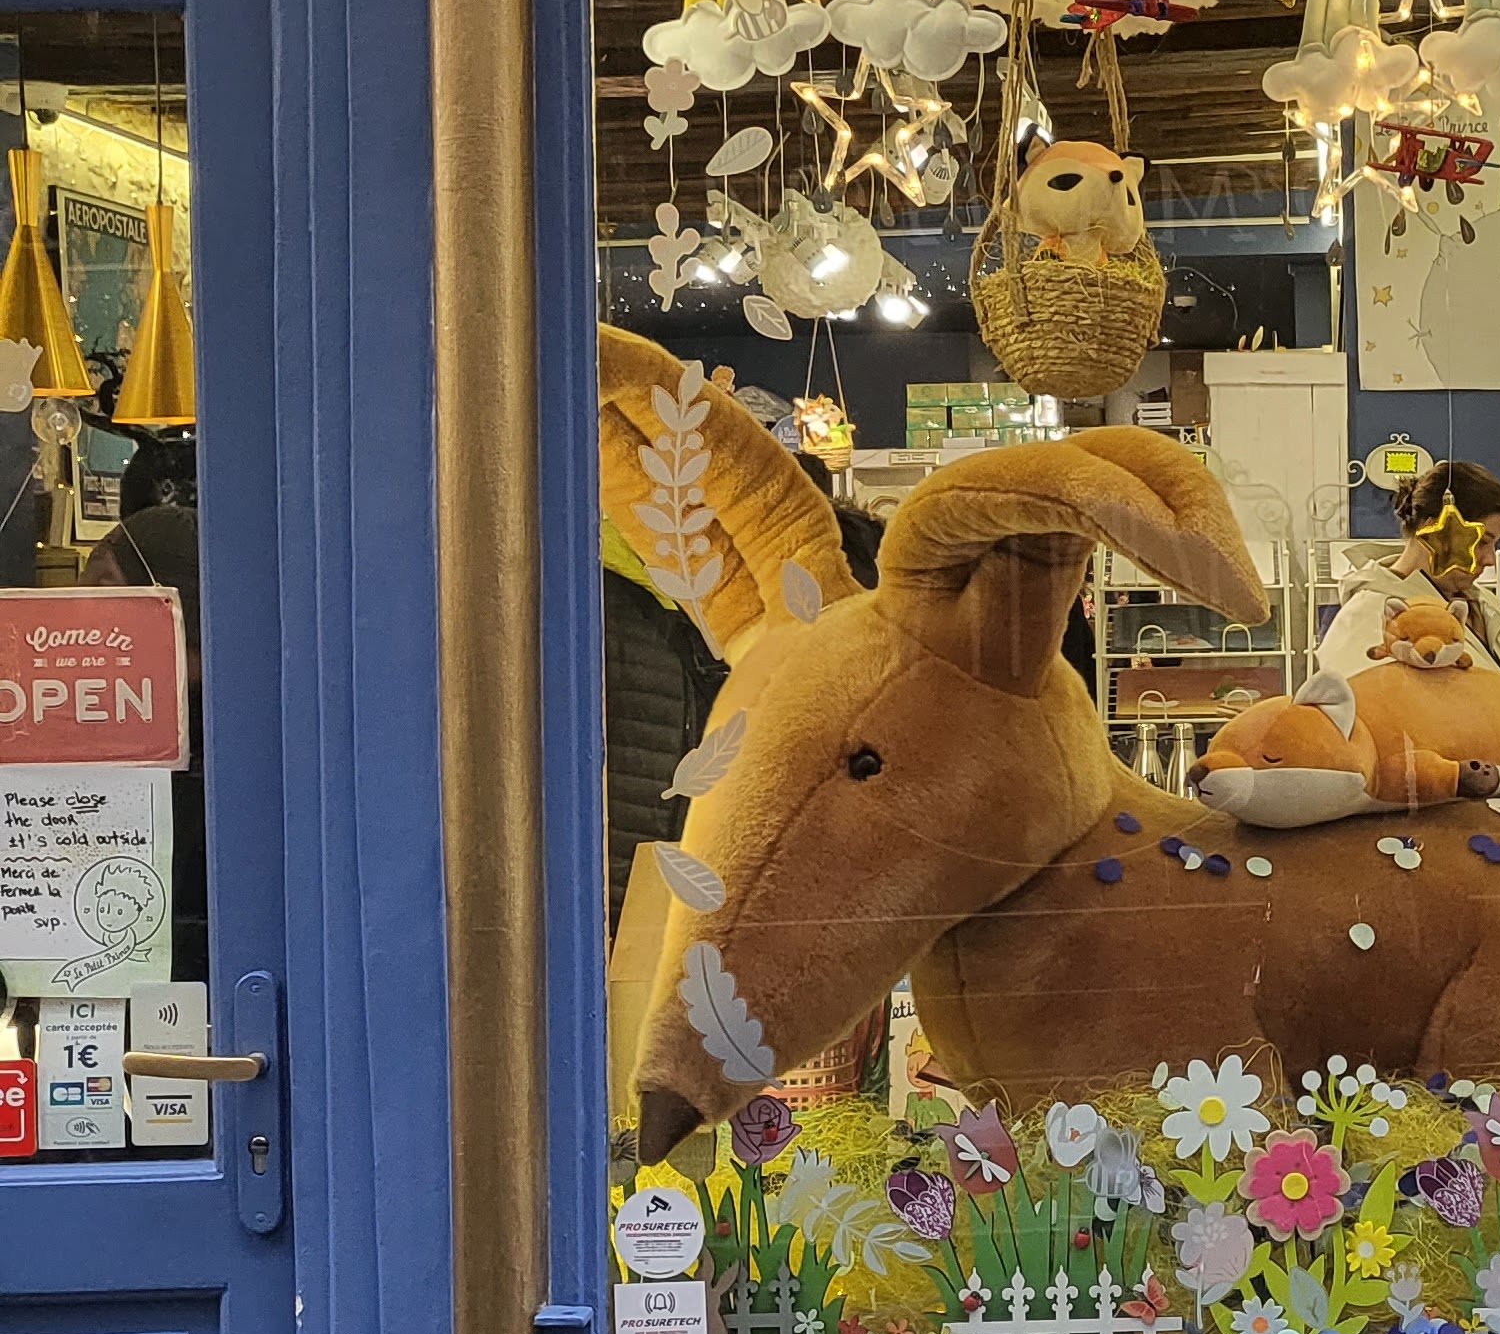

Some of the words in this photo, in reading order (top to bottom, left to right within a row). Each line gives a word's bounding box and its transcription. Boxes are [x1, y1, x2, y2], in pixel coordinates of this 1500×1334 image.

[68, 200, 147, 244] AEROPOSTALE
[26, 627, 101, 652] Come
[105, 627, 133, 651] in
[56, 656, 77, 667] we
[82, 656, 106, 667] are
[0, 677, 152, 724] OPEN
[4, 792, 56, 807] Please
[65, 791, 107, 807] close
[4, 811, 32, 828] the
[55, 831, 90, 846] cold
[1, 867, 36, 880] Merci
[41, 867, 61, 879] de
[47, 882, 62, 898] la
[69, 1004, 95, 1018] ICI
[45, 1024, 71, 1032] carte
[73, 1022, 118, 1032] acceptée
[63, 1044, 98, 1069] 1€
[90, 1098, 110, 1106] VISA
[152, 1103, 187, 1116] VISA
